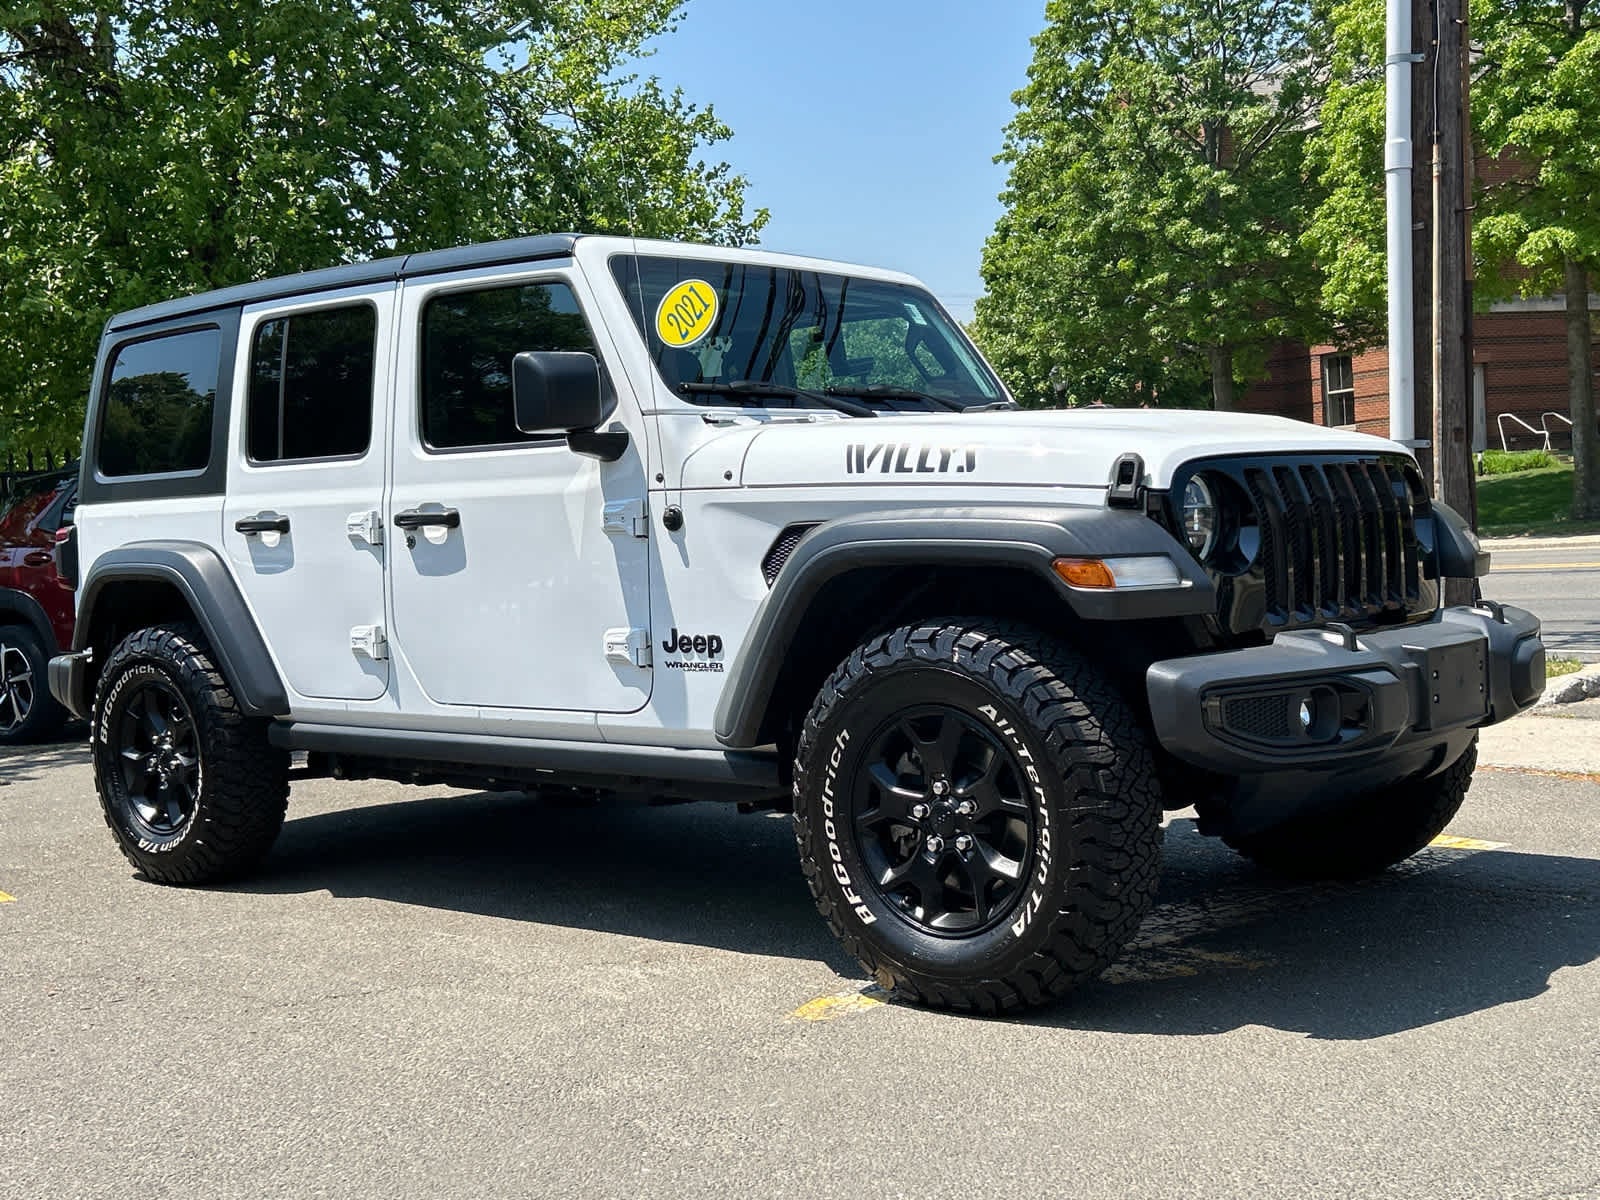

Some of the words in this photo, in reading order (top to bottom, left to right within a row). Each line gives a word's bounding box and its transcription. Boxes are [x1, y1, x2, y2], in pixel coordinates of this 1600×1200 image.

[667, 285, 710, 340] 2021
[662, 627, 723, 659] Jeep
[664, 660, 724, 669] WRANGLER
[100, 664, 155, 744] BFGoodrich
[821, 728, 878, 925] BFGoodrich
[1012, 890, 1044, 937] T/A
